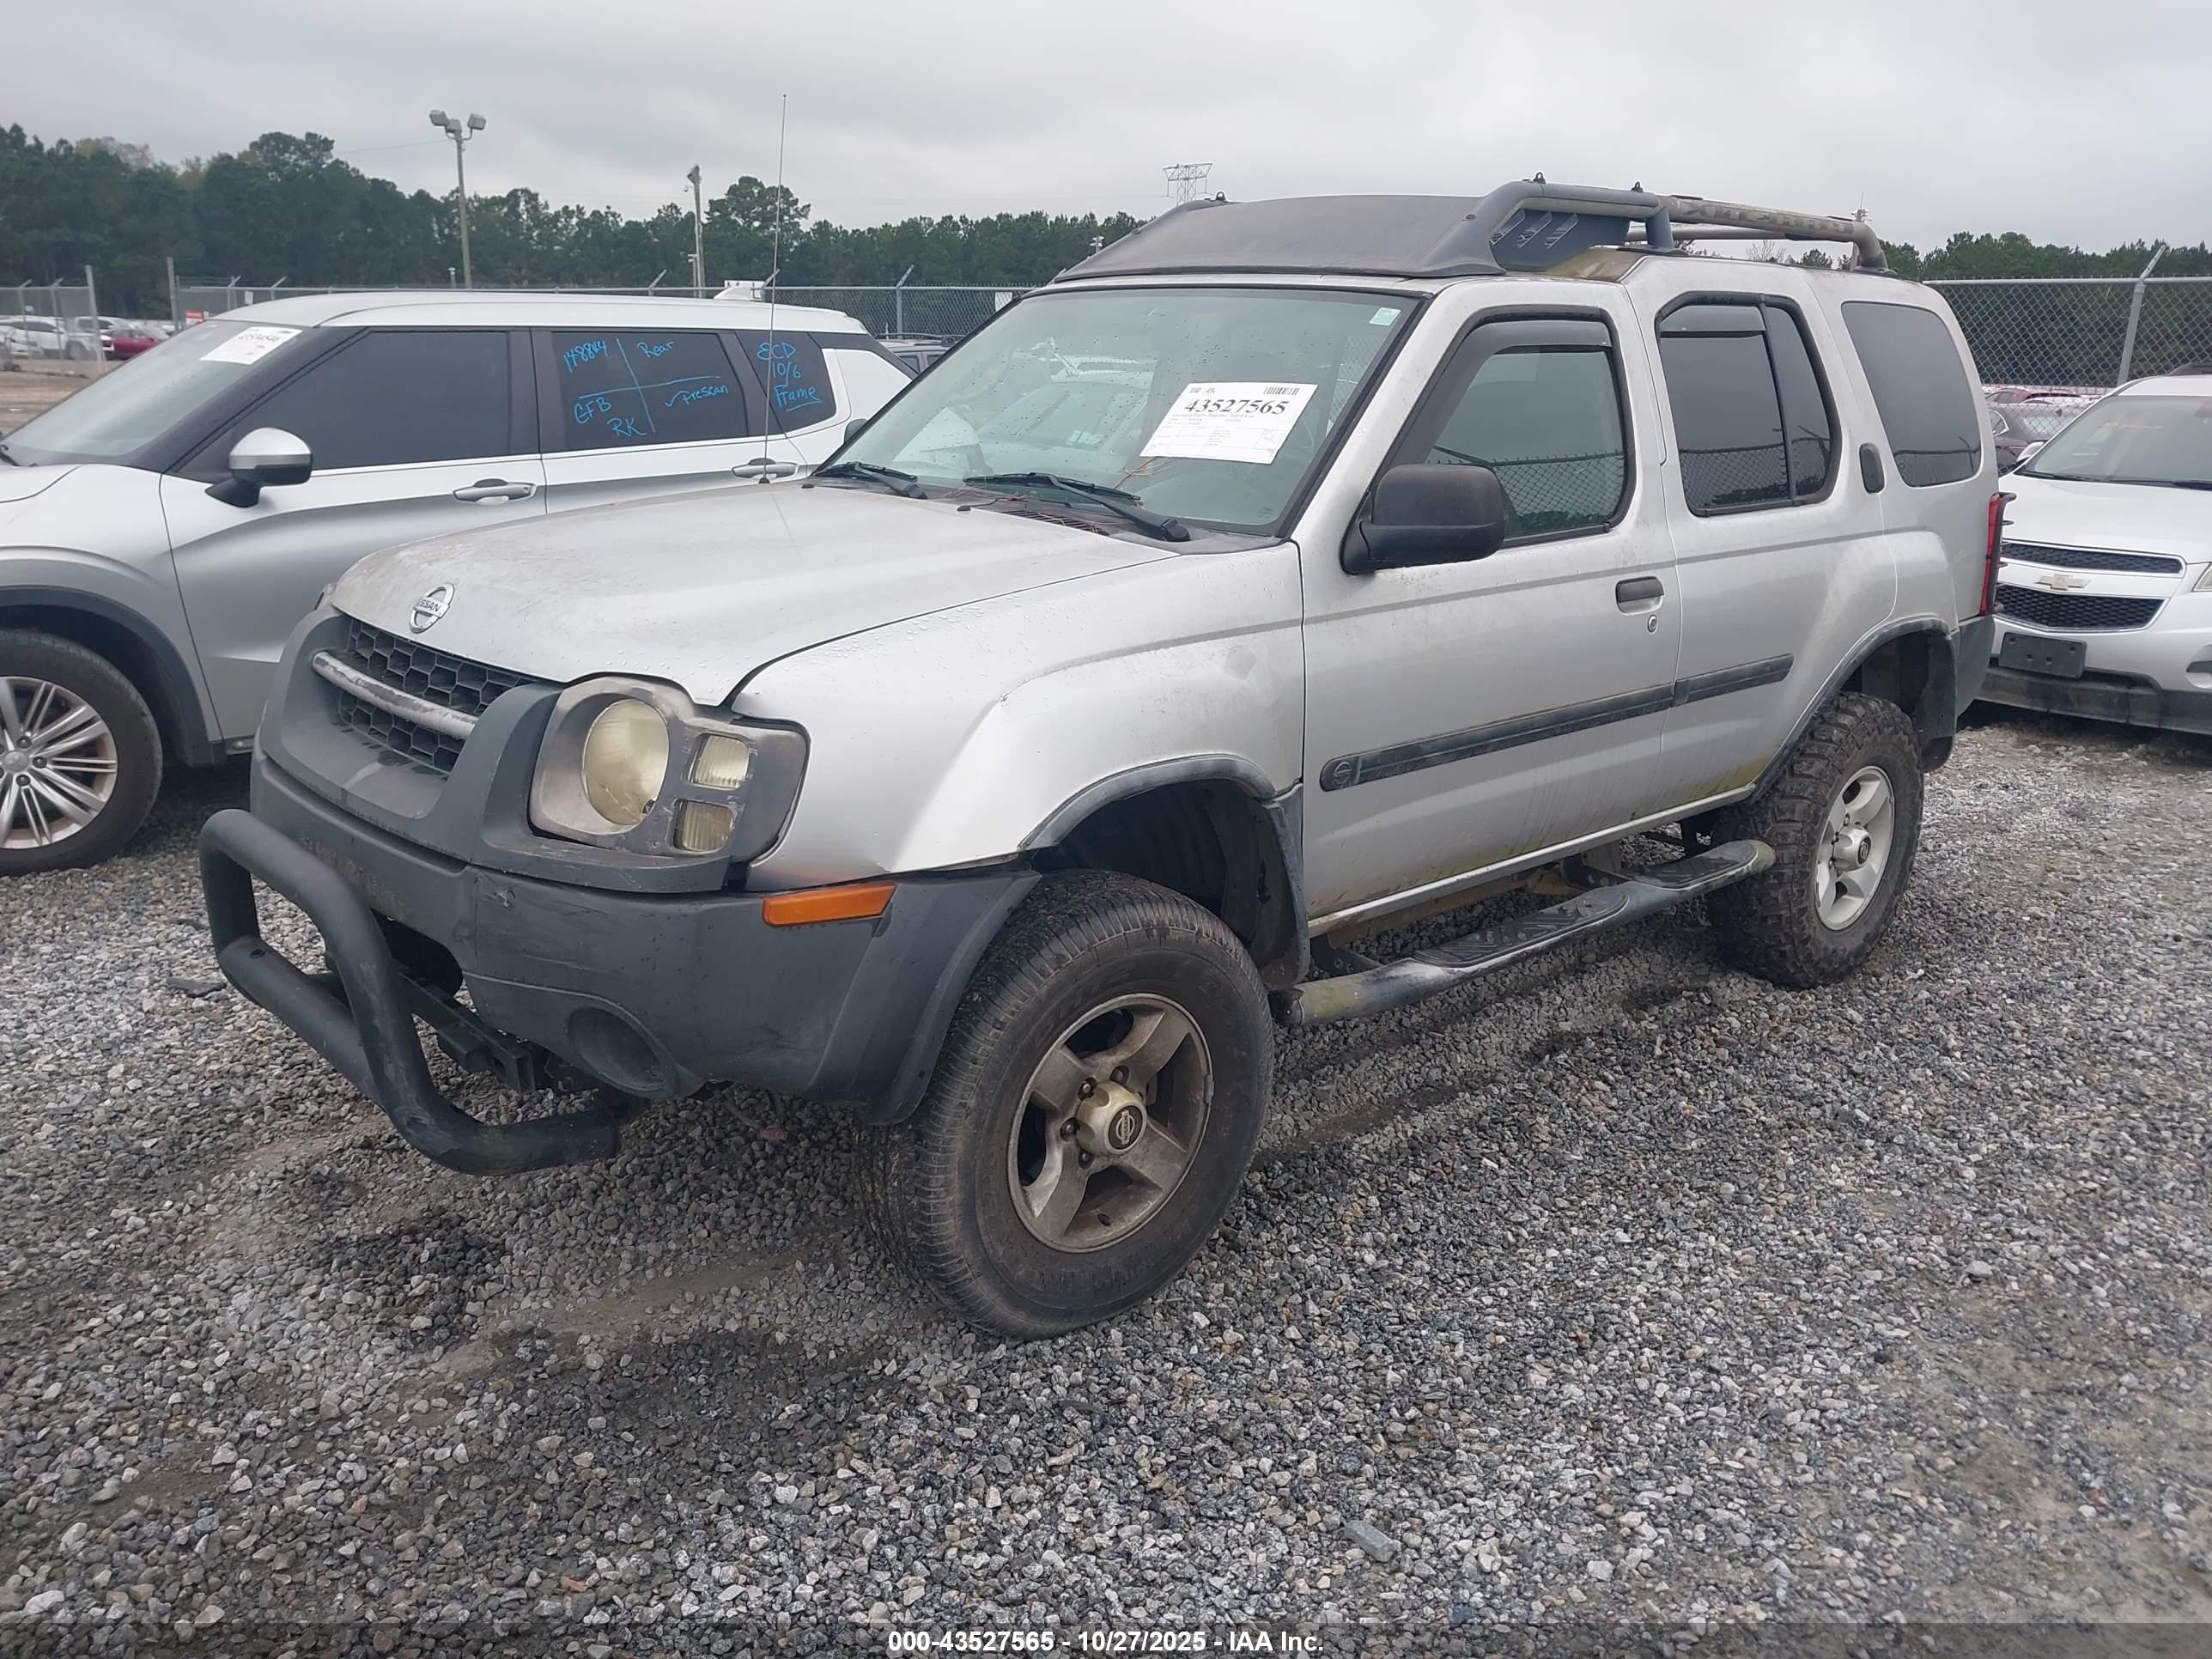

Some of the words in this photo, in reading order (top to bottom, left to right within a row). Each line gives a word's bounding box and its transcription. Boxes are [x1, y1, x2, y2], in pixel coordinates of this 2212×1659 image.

[638, 341, 674, 357] Rear
[774, 384, 821, 408] Frame
[1185, 398, 1289, 414] 43527565
